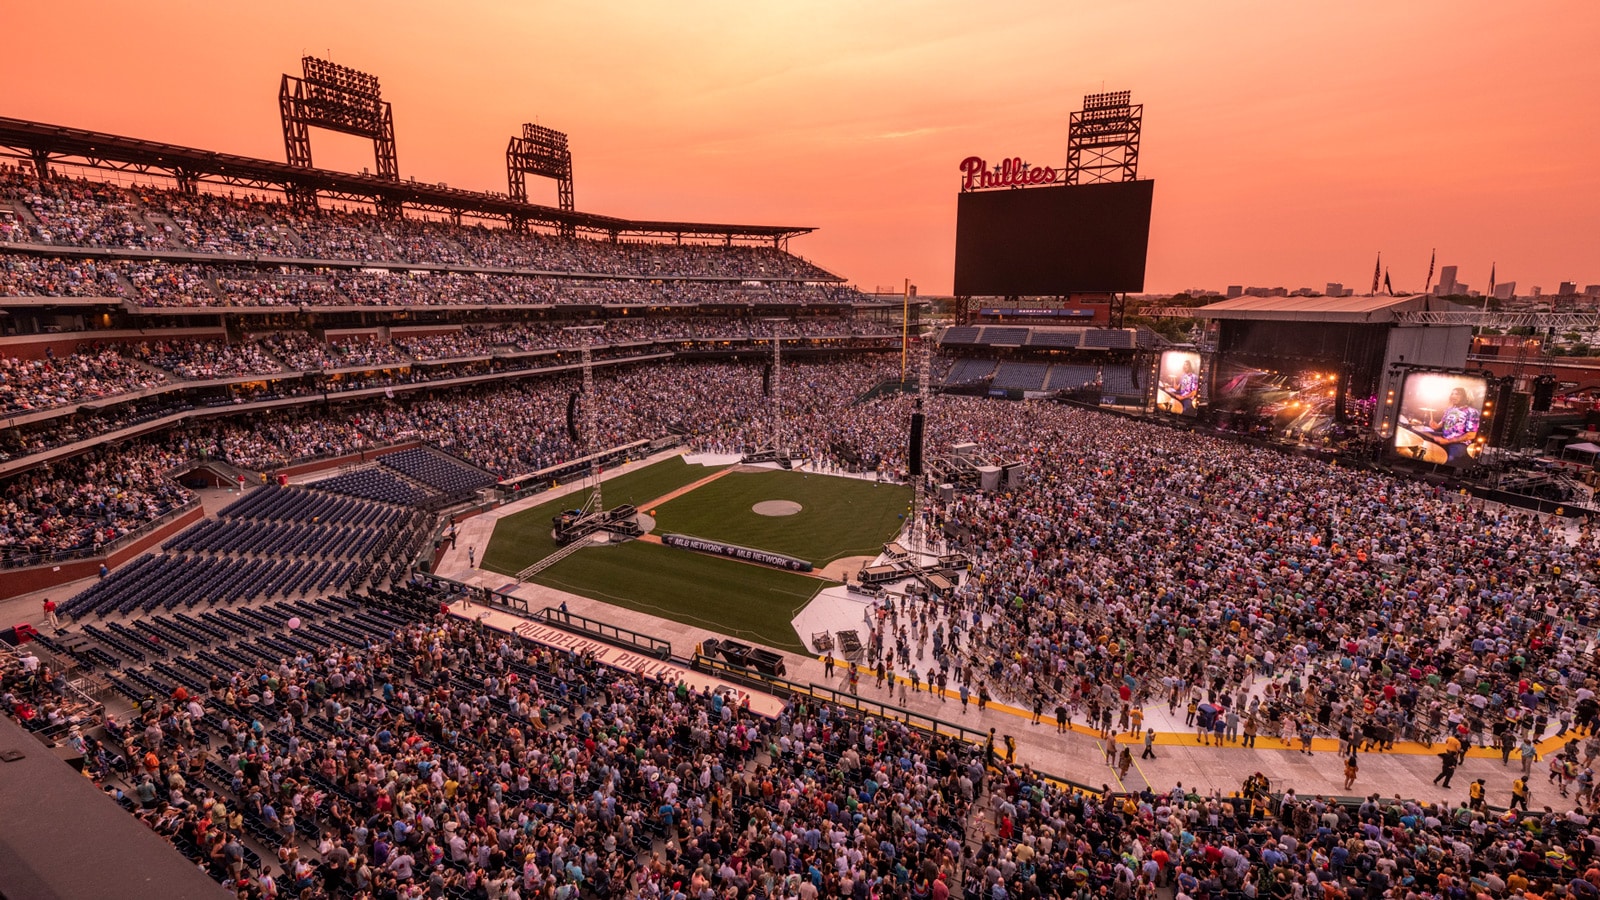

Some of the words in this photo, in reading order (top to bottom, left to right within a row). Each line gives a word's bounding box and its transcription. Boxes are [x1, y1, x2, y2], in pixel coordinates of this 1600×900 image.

[959, 156, 1057, 189] Phillies
[674, 538, 690, 547] MLB
[690, 540, 723, 553] NETWORK
[736, 549, 752, 559] MLB
[752, 551, 788, 567] NETWORK
[516, 621, 610, 659] PHILADELPHIA
